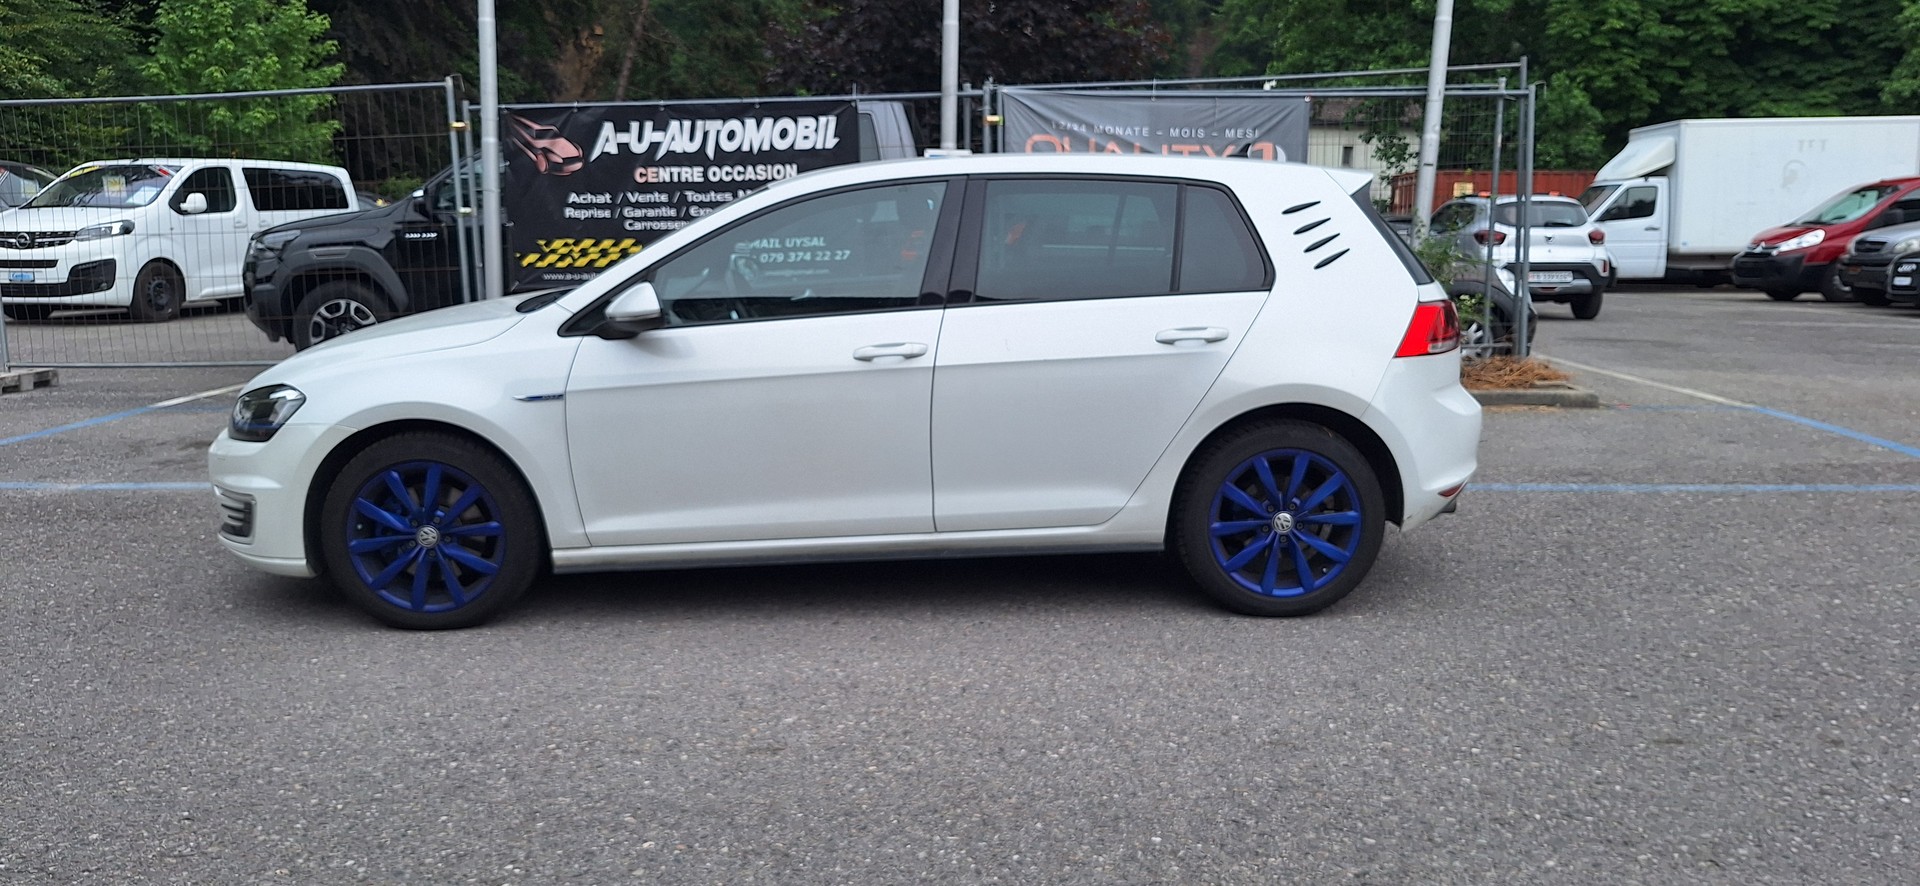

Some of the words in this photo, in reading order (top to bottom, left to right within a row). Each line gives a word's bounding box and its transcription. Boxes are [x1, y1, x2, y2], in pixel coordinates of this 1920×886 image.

[589, 115, 840, 162] A-U-AUTOMOBIL
[1094, 125, 1149, 136] MONATE
[1169, 127, 1204, 138] MOIS
[1225, 128, 1259, 139] MESI
[634, 165, 704, 183] CENTRE
[707, 163, 798, 183] OCCASION
[568, 191, 612, 204] Achat
[626, 190, 669, 203] Vente
[684, 189, 733, 203] Toutes
[564, 206, 611, 220] Reprise
[622, 205, 677, 218] Garantie
[785, 236, 826, 247] UYSAL
[760, 252, 785, 263] 079
[787, 251, 812, 262] 374
[815, 250, 832, 261] 22
[834, 249, 851, 260] 27
